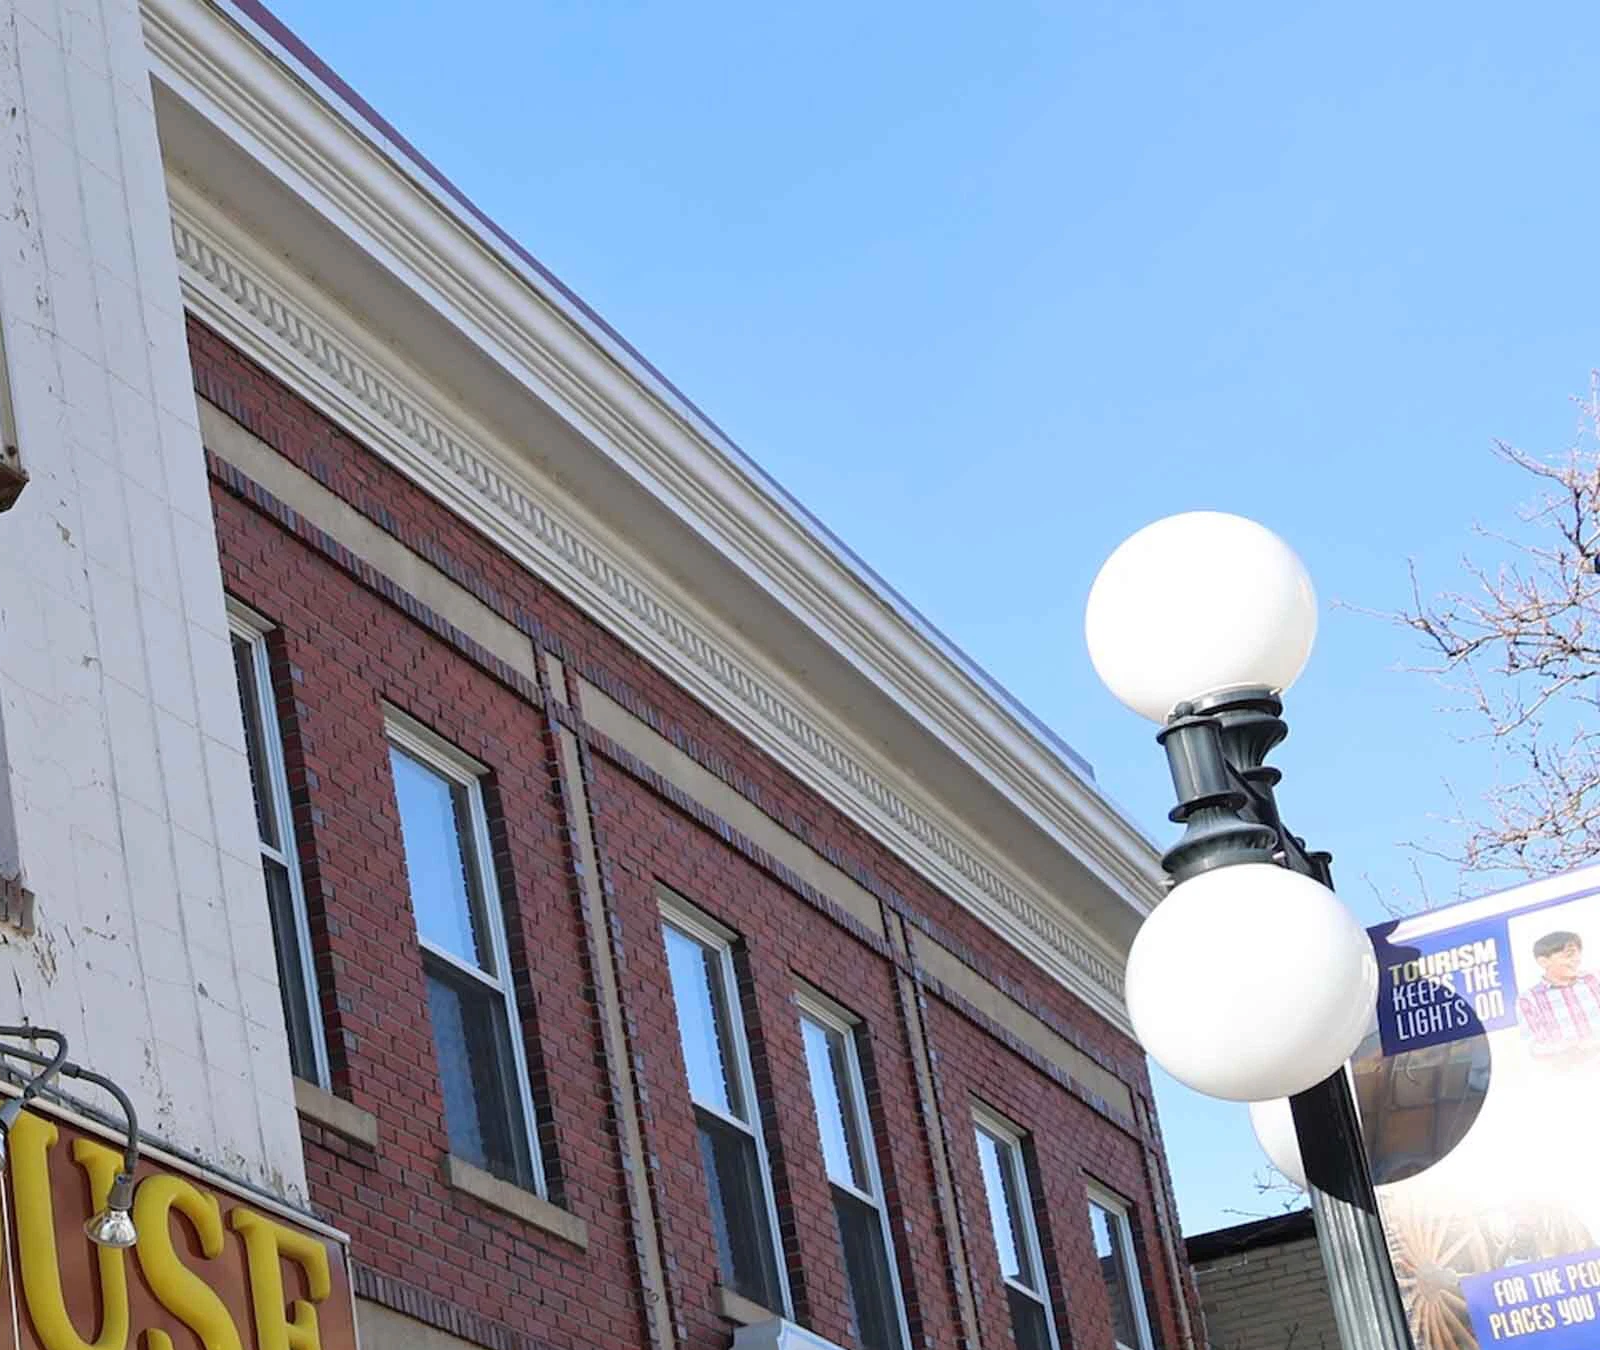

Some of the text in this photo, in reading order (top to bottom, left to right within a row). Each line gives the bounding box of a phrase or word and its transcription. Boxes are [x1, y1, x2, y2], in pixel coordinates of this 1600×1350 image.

[1388, 938, 1497, 985] TOURISM
[1392, 961, 1502, 1011] KEEPS THE
[1396, 989, 1505, 1040] LIGHTS ON
[1493, 1276, 1529, 1307] FOR
[1528, 1267, 1566, 1298] THE
[1488, 1293, 1596, 1340] PLACES YOU
